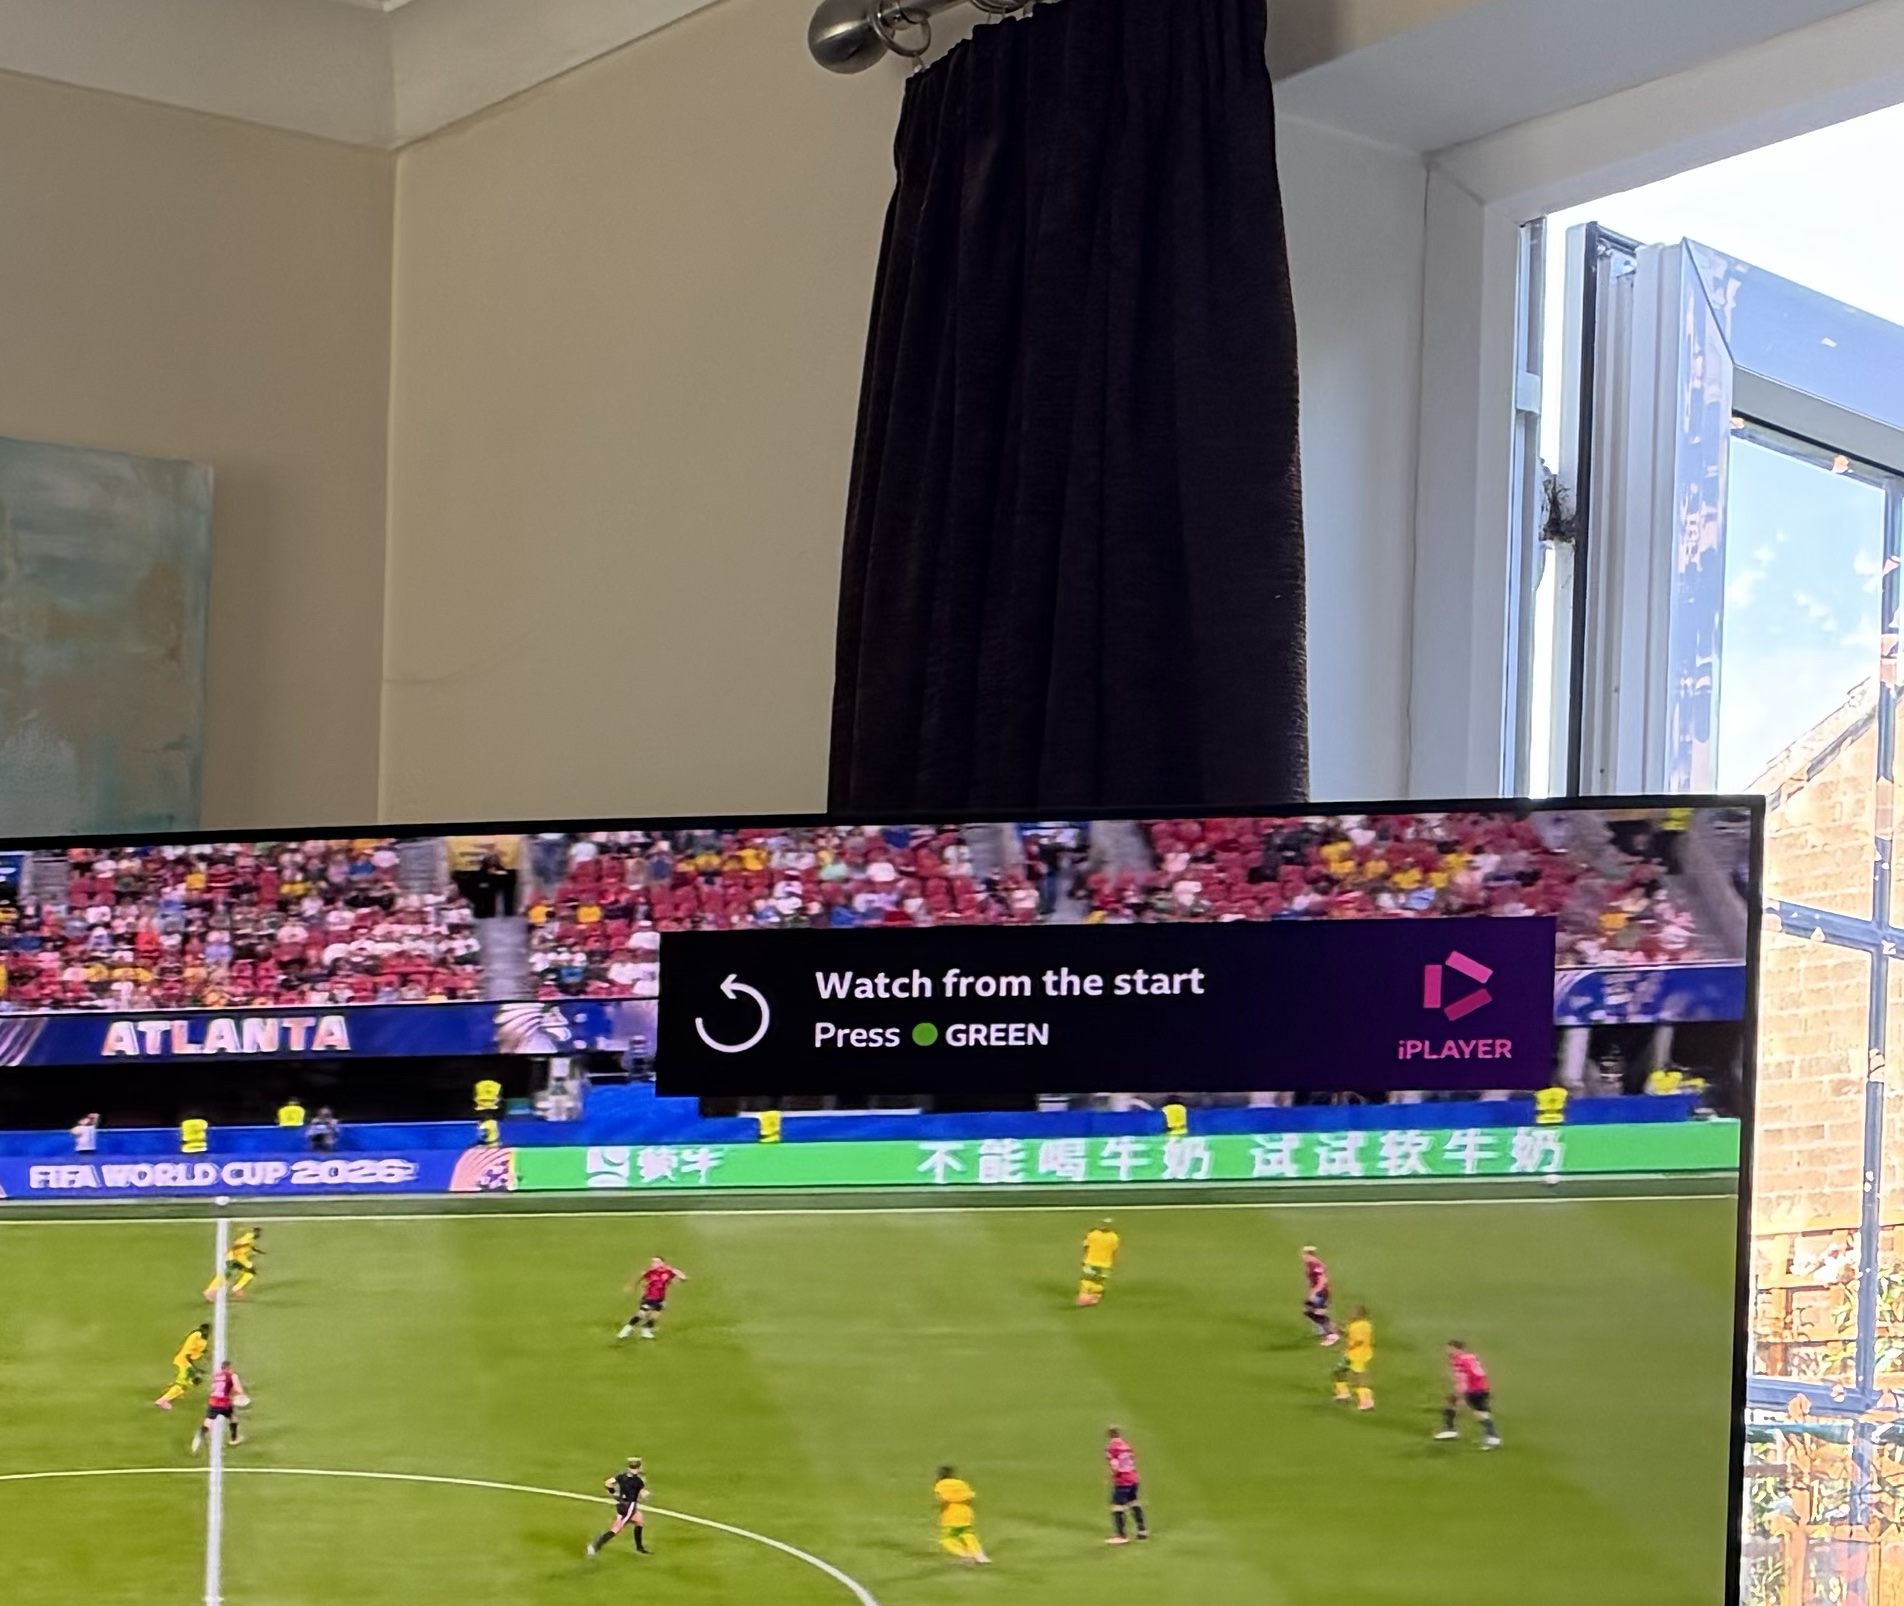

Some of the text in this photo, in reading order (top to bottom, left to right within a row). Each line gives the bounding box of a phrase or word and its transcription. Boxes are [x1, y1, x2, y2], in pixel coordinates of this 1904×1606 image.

[815, 967, 1205, 999] Watch from the start
[101, 1015, 352, 1056] ATLANTA
[814, 1022, 1049, 1048] Press GREEN
[1398, 1039, 1512, 1060] iPLAYER
[29, 1164, 100, 1189] FIFA
[101, 1162, 222, 1188] WORLD
[221, 1160, 290, 1186] CUP
[916, 1136, 1213, 1184] 不能喝牛奶
